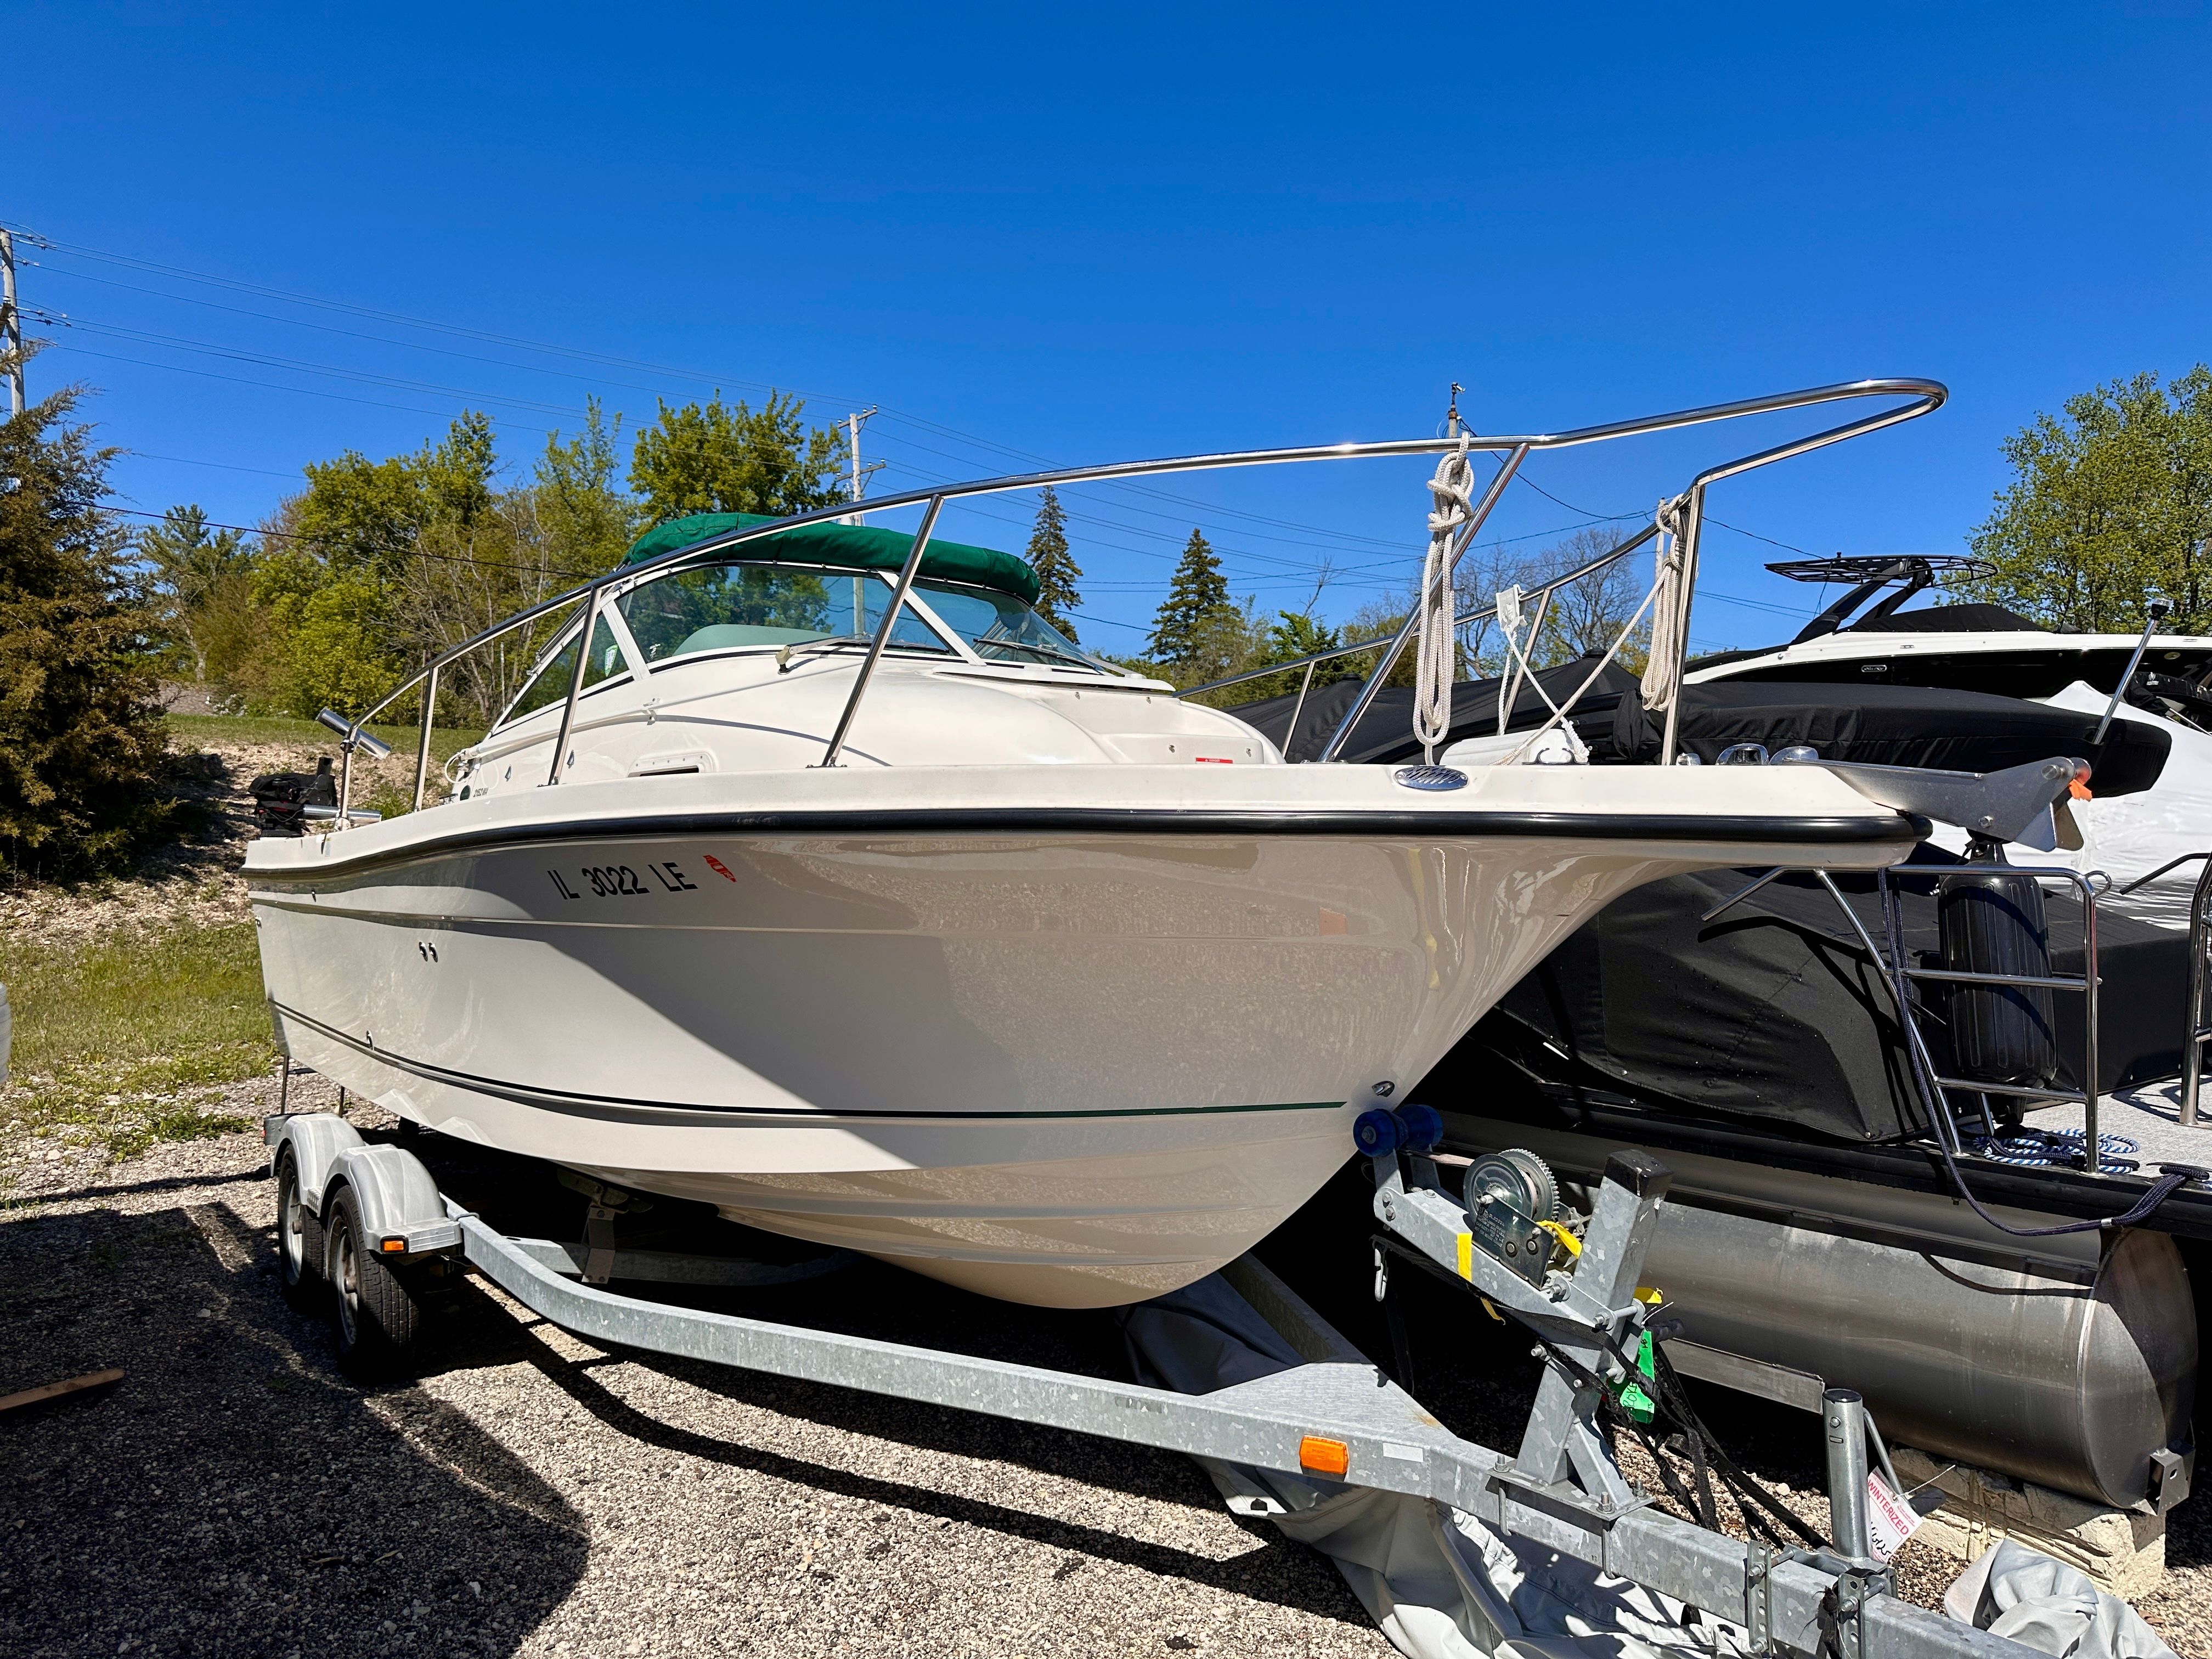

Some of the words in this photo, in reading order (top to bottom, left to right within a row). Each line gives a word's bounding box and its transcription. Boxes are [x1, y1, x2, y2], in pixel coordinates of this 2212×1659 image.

[547, 870, 580, 900] IL
[582, 865, 650, 897] 3022
[647, 862, 698, 892] LE
[1513, 1216, 1519, 1225] 7
[1867, 1478, 1909, 1535] WINTERIZED
